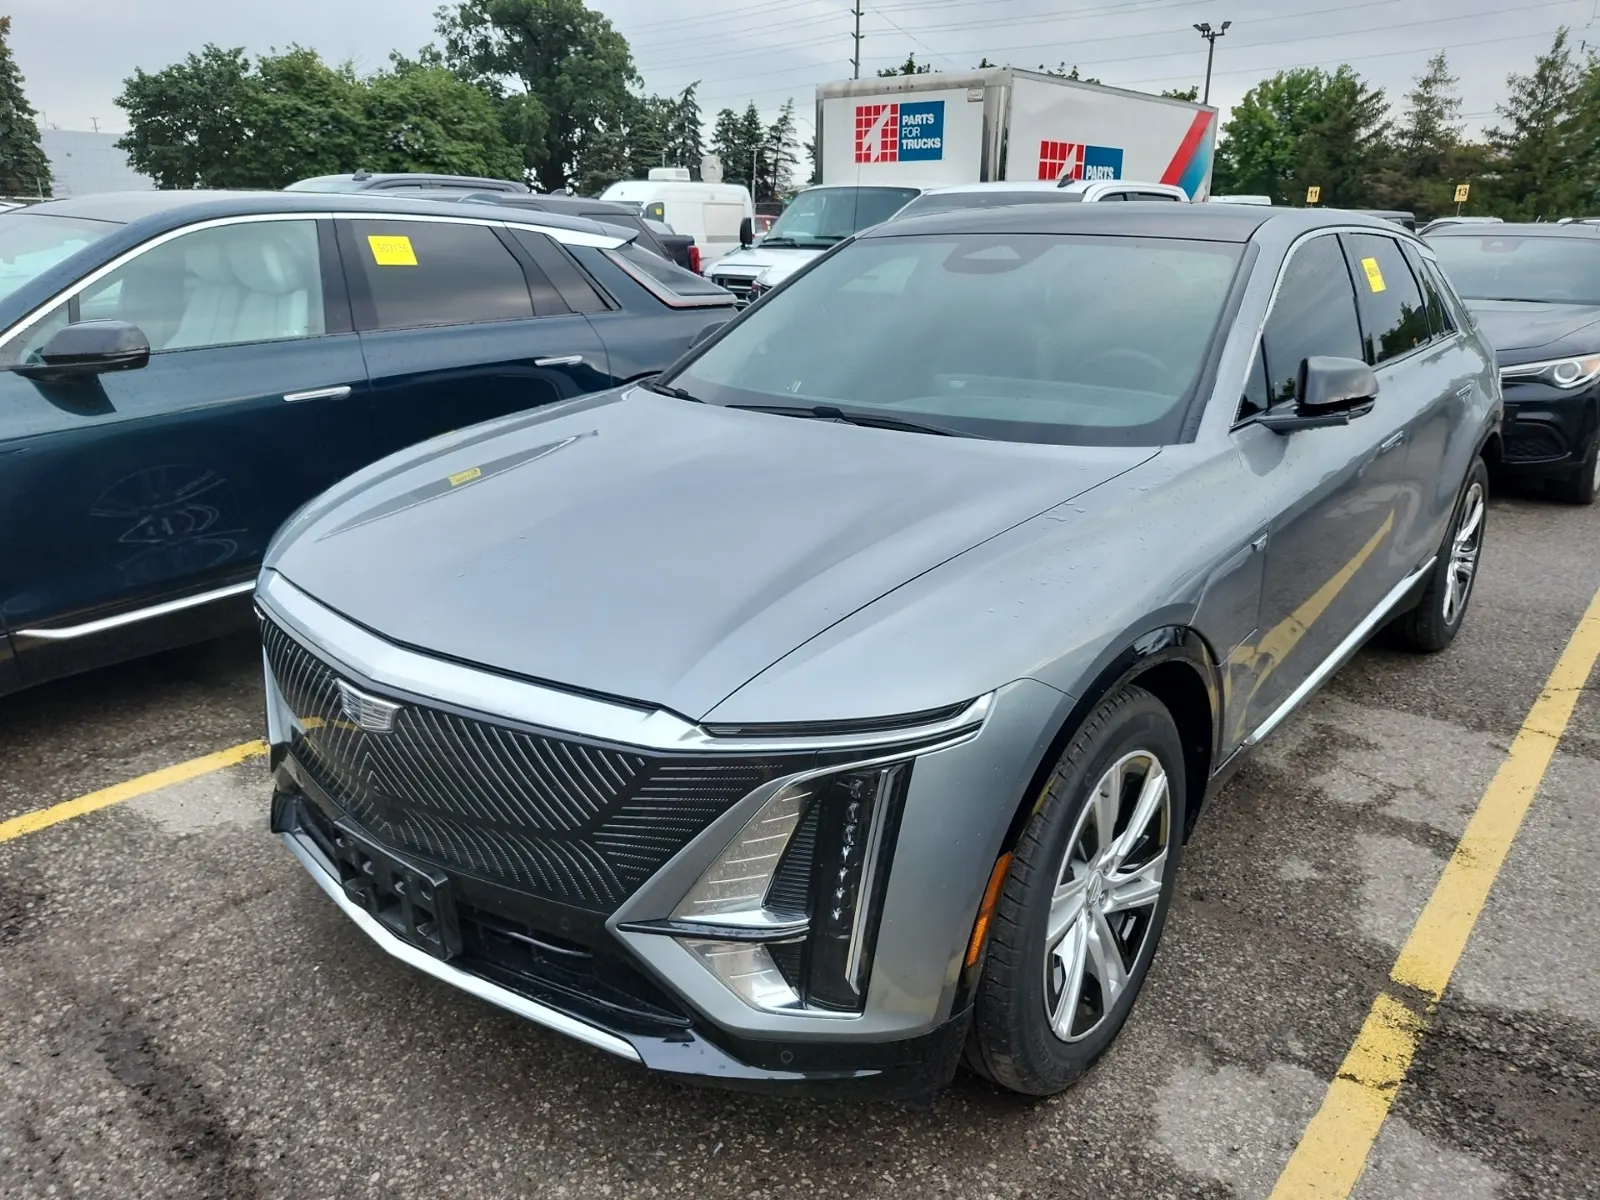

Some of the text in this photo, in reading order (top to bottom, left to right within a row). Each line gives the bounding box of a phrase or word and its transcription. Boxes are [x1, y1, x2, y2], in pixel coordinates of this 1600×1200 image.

[902, 113, 934, 125] PARTS
[902, 126, 921, 138] FOR
[901, 138, 941, 150] TRUCKS
[1085, 165, 1114, 180] PARTS
[1309, 190, 1318, 198] 11
[1457, 187, 1467, 197] 13
